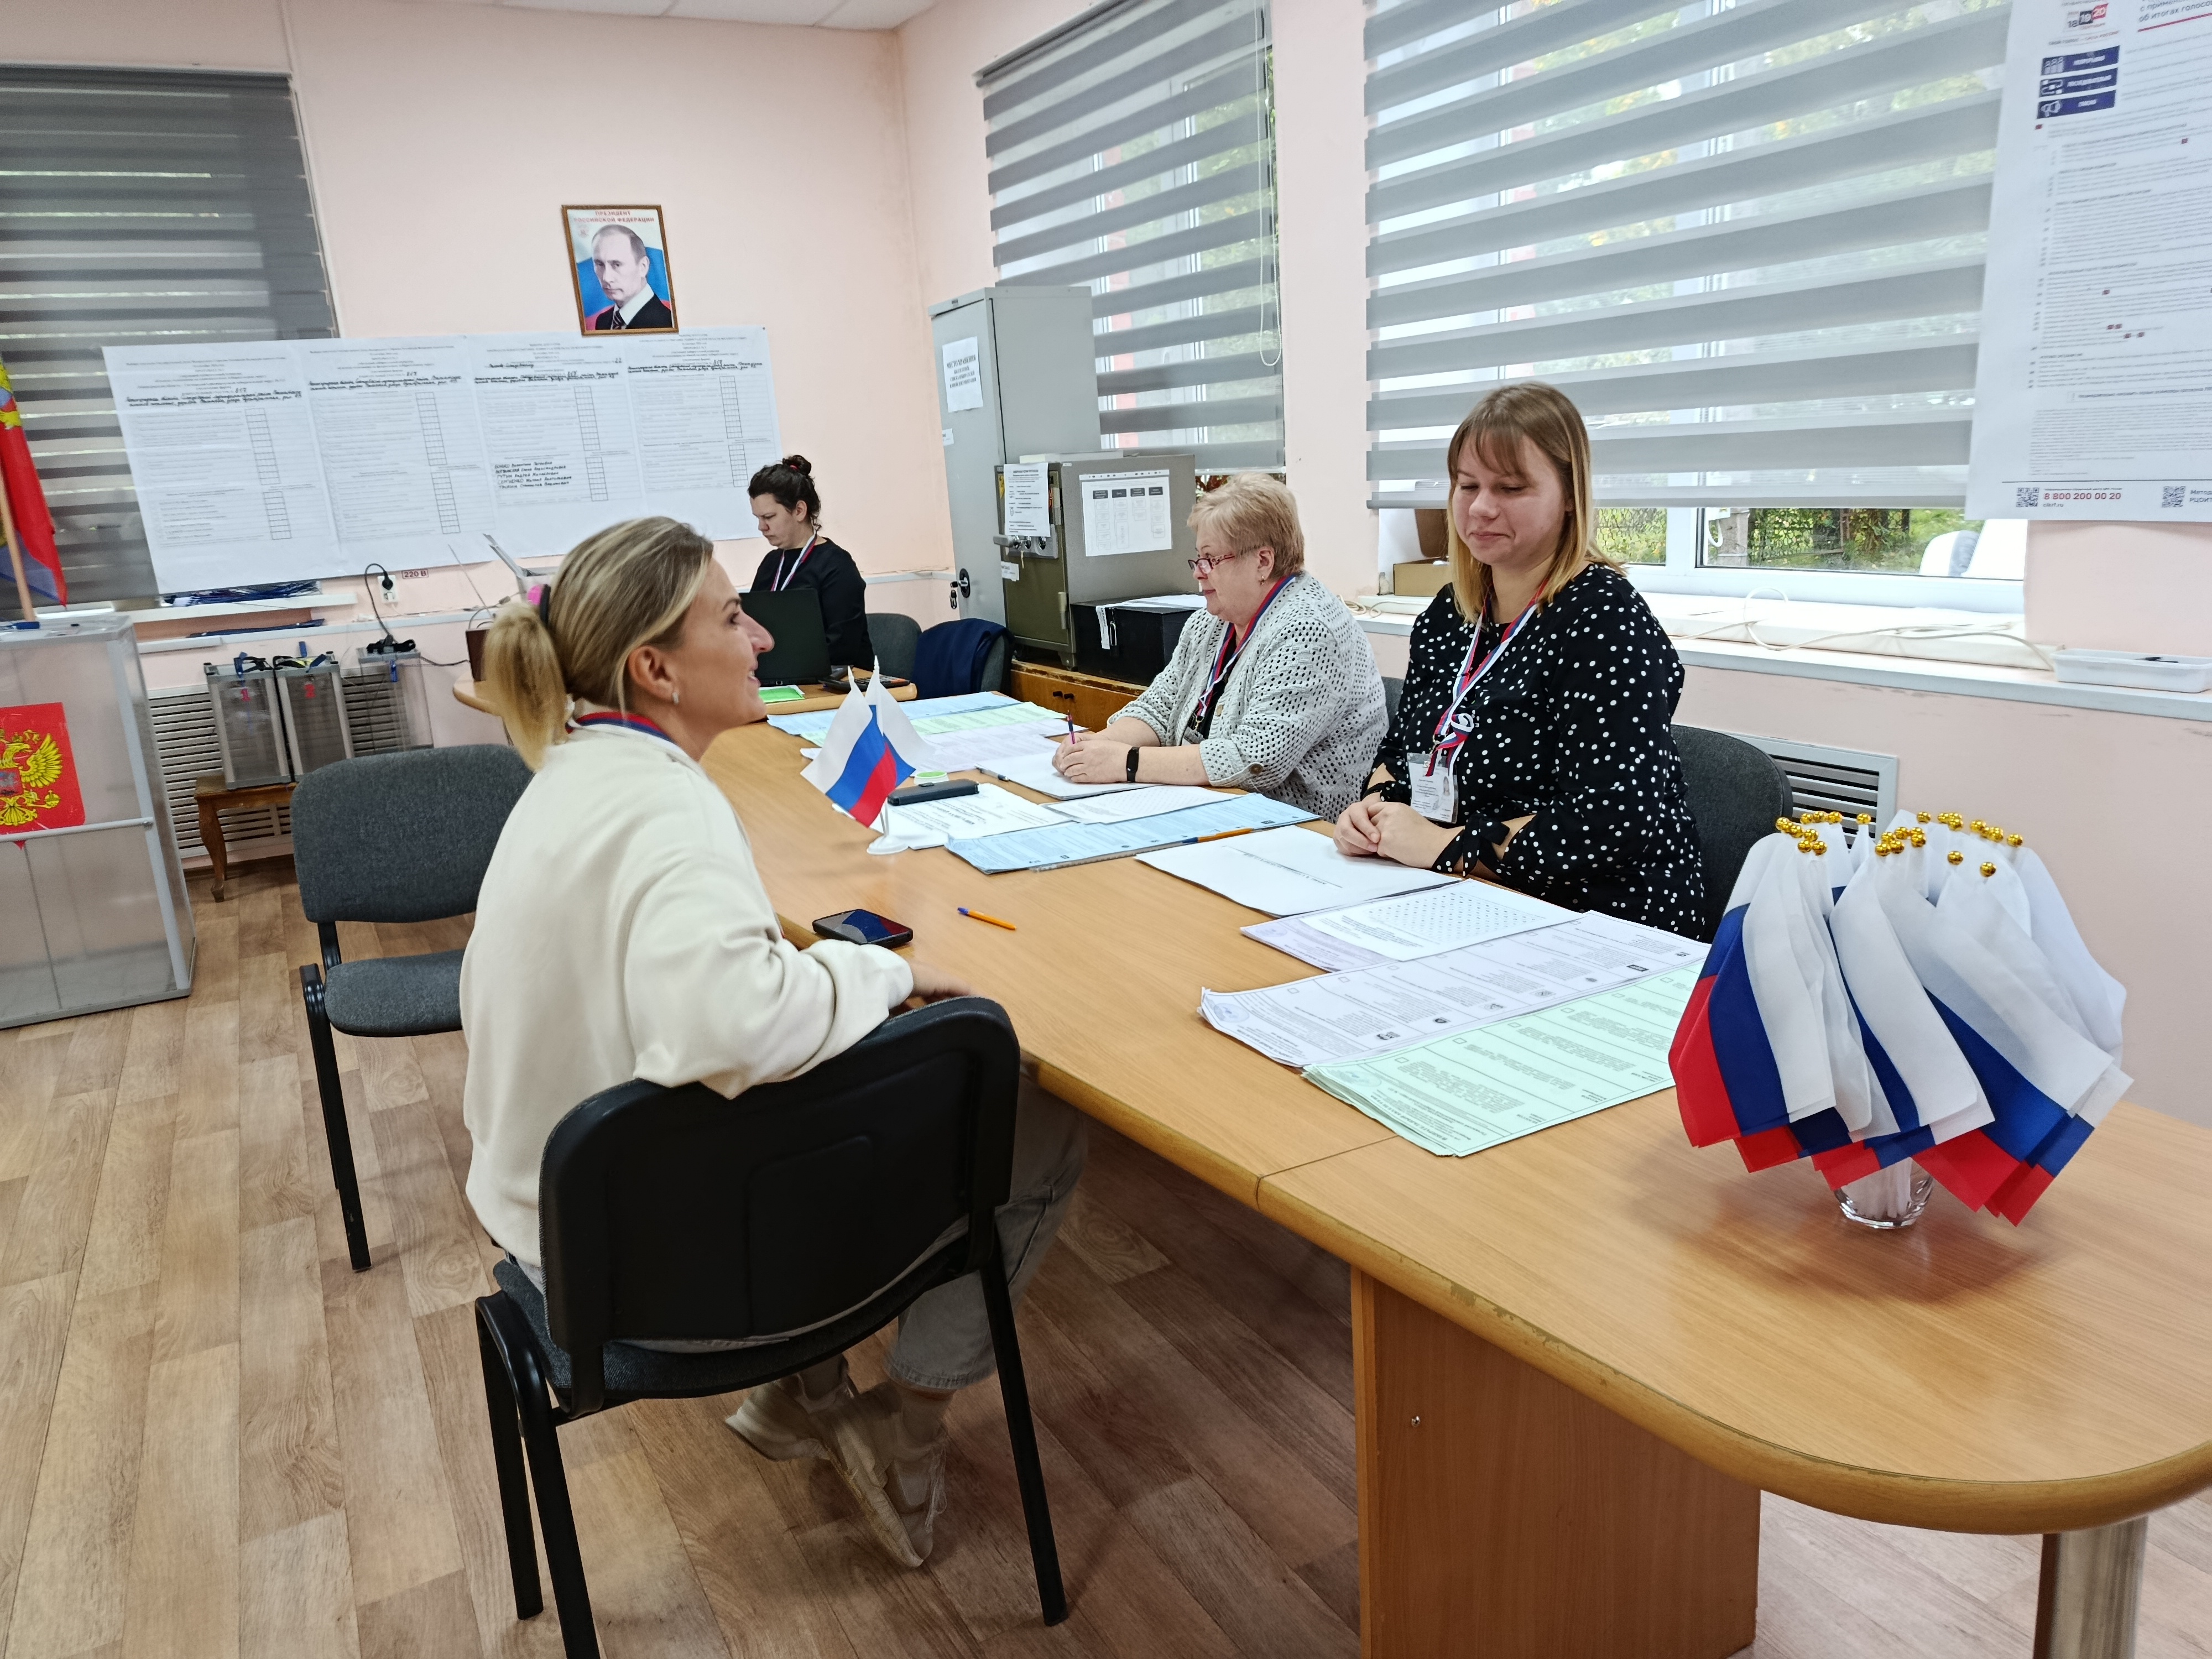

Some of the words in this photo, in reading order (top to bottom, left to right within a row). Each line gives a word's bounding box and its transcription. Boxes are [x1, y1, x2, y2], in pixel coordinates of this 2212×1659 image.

[2068, 19, 2079, 28] 18
[2093, 7, 2106, 17] 20
[2138, 13, 2150, 22] об
[2151, 8, 2179, 19] итогах
[240, 687, 252, 702] 1
